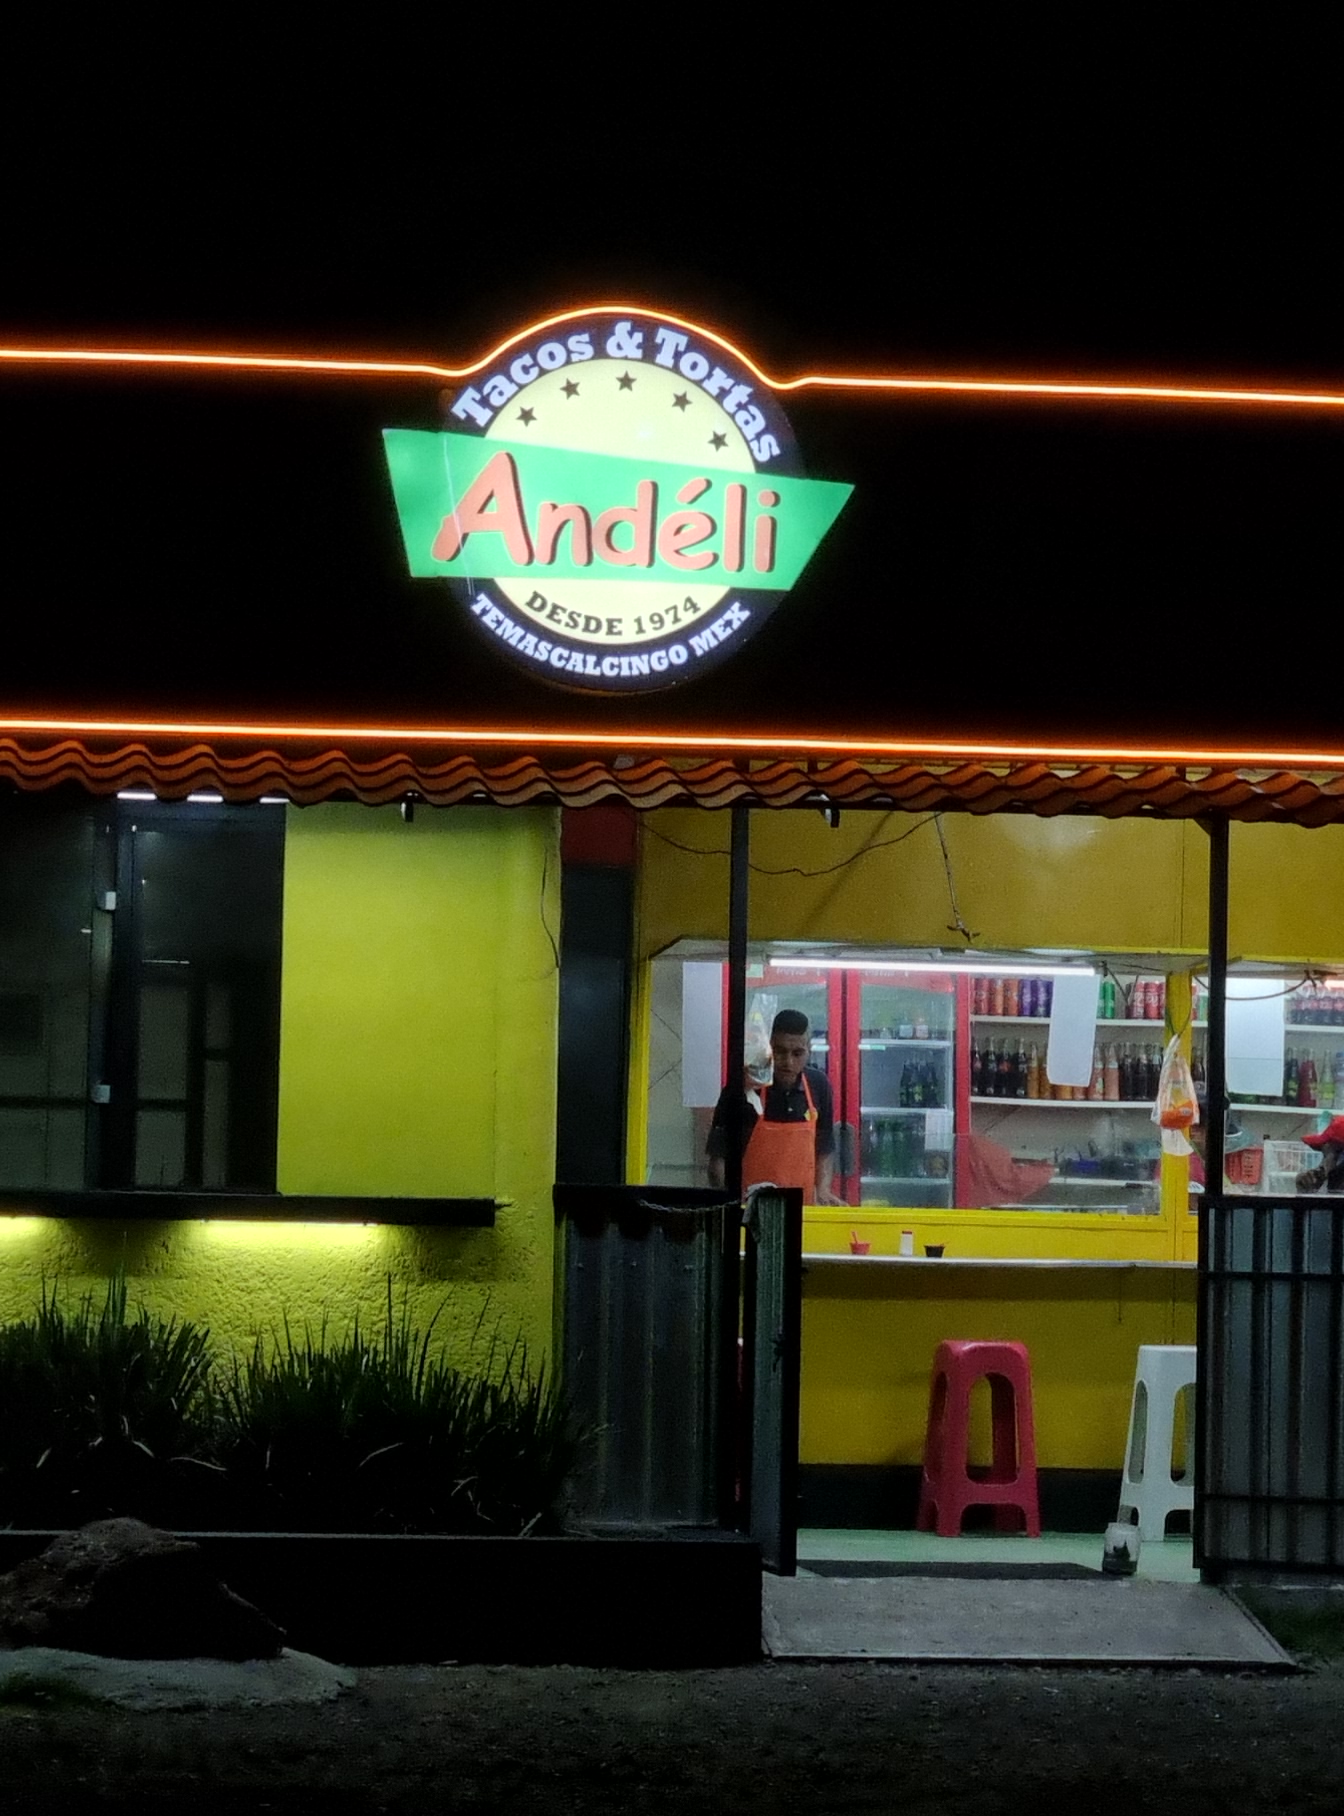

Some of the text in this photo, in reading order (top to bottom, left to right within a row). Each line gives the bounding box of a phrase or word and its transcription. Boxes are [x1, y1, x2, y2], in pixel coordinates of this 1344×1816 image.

[451, 321, 782, 464] Tacos & Tortas
[431, 450, 782, 575] Andéli
[470, 592, 752, 678] TEMASCALCINGO MEX
[525, 591, 702, 636] DESDE 1974
